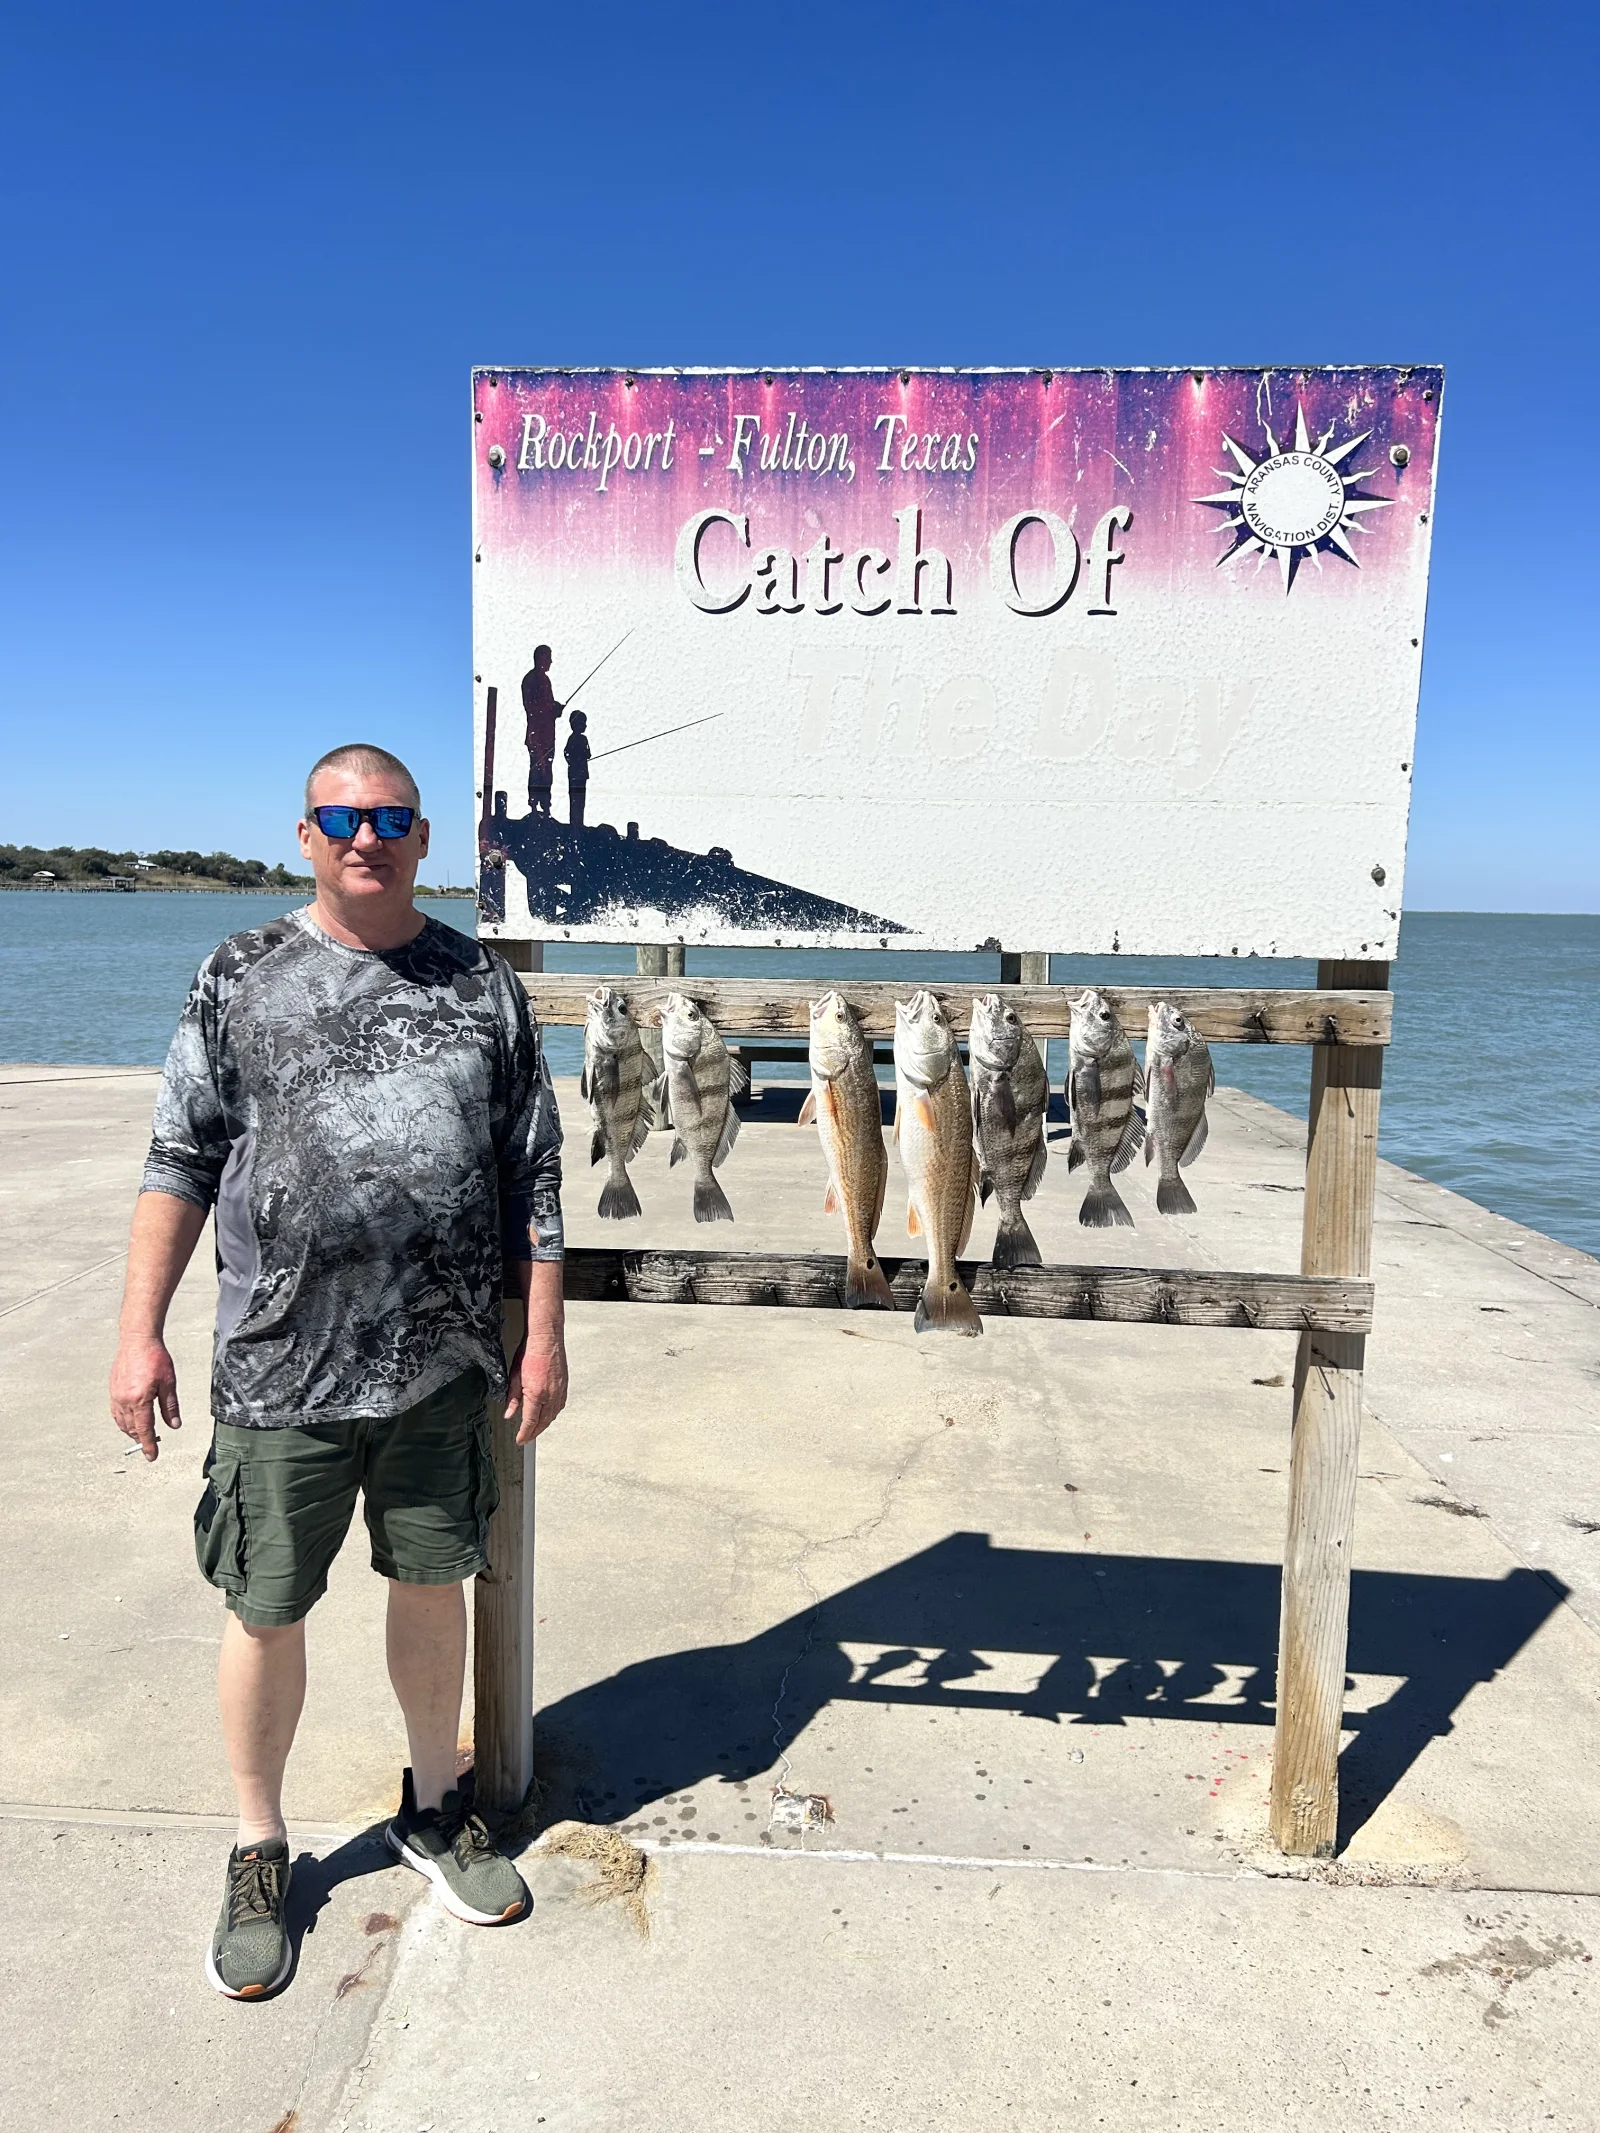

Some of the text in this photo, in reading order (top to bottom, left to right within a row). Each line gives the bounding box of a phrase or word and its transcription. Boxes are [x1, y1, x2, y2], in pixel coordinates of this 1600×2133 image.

[517, 412, 675, 491] Rockport
[873, 413, 979, 471] Texas
[1247, 456, 1341, 495] ARANSAS COUNTY
[674, 505, 1132, 617] Catch Of
[1247, 501, 1340, 542] NAVIGATION DIST.
[790, 646, 1260, 794] The Day
